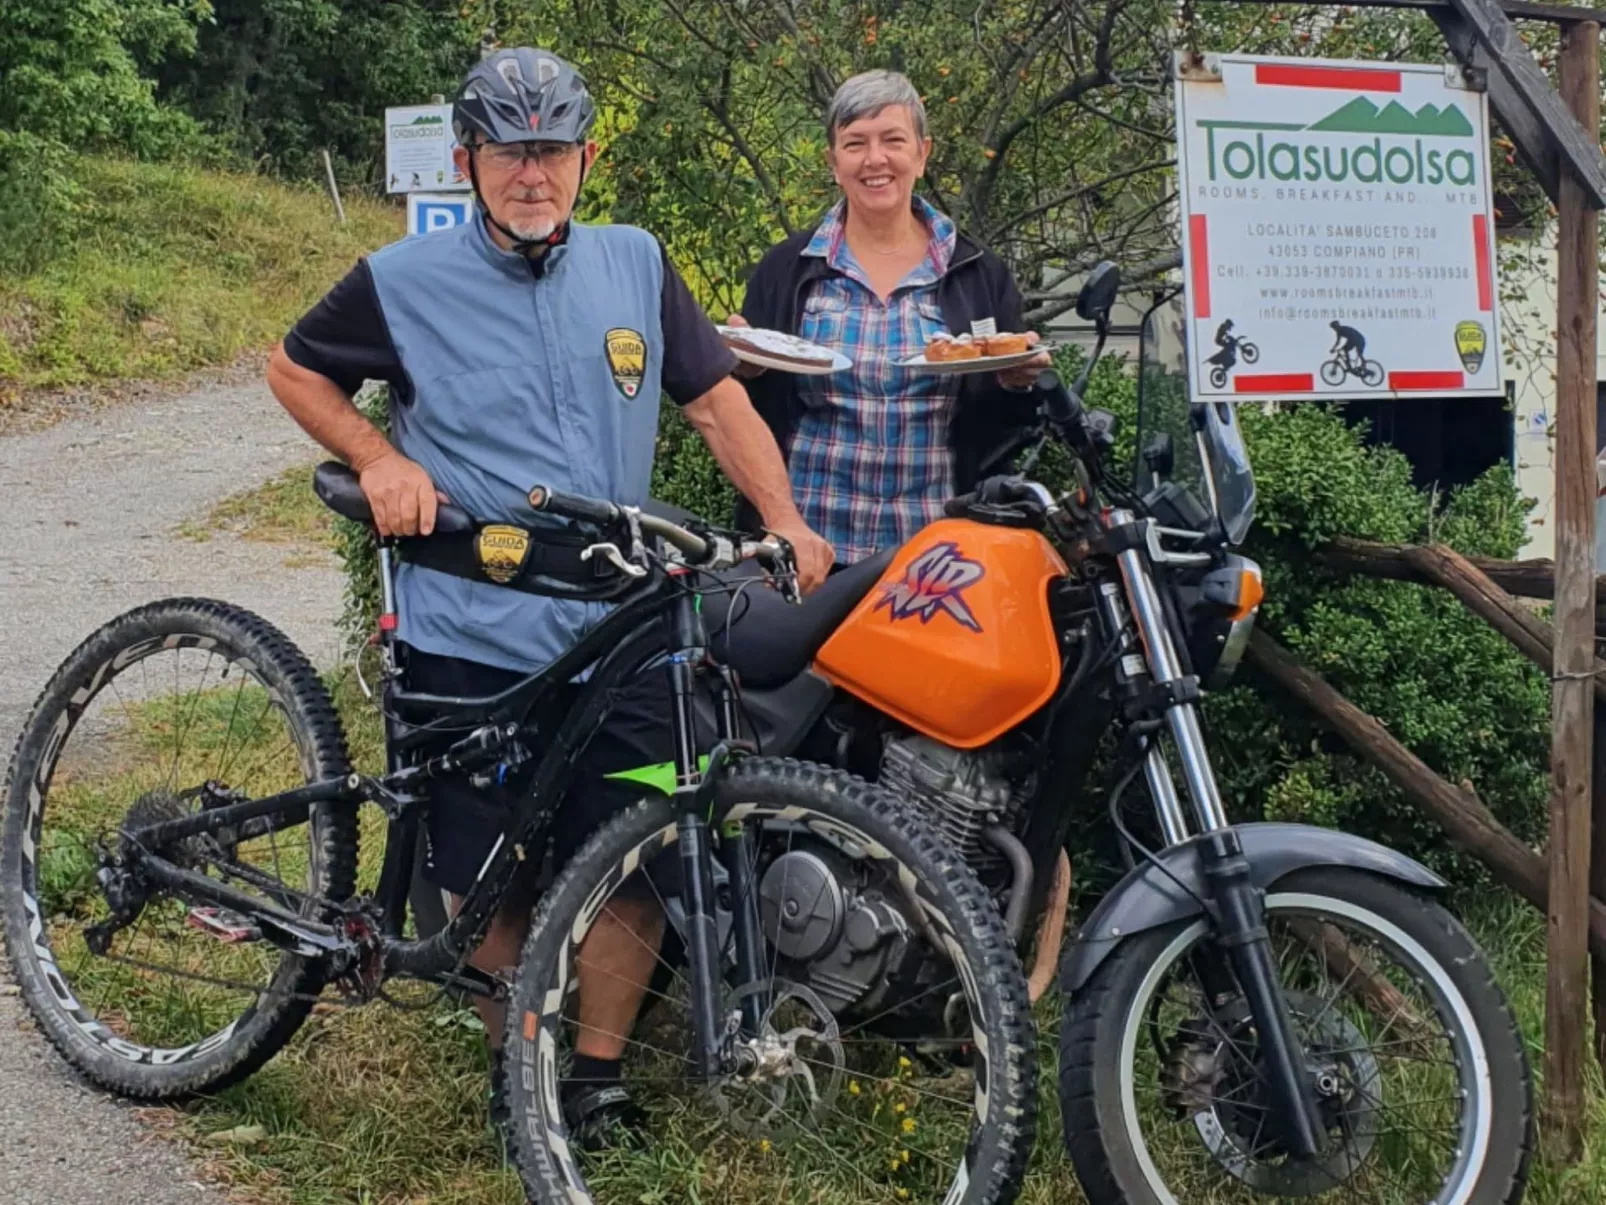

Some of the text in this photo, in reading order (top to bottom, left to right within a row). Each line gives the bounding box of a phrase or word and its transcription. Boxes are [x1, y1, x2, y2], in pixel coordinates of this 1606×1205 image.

[1196, 120, 1476, 186] Tolasudolsa
[1276, 187, 1374, 202] BREAKFAST
[1446, 192, 1477, 205] MTB
[426, 207, 456, 232] P
[1326, 224, 1409, 239] SAMBUCETO
[1313, 244, 1386, 259] COMPIANO
[1392, 245, 1420, 260] (PR)
[482, 535, 525, 549] GUIDA
